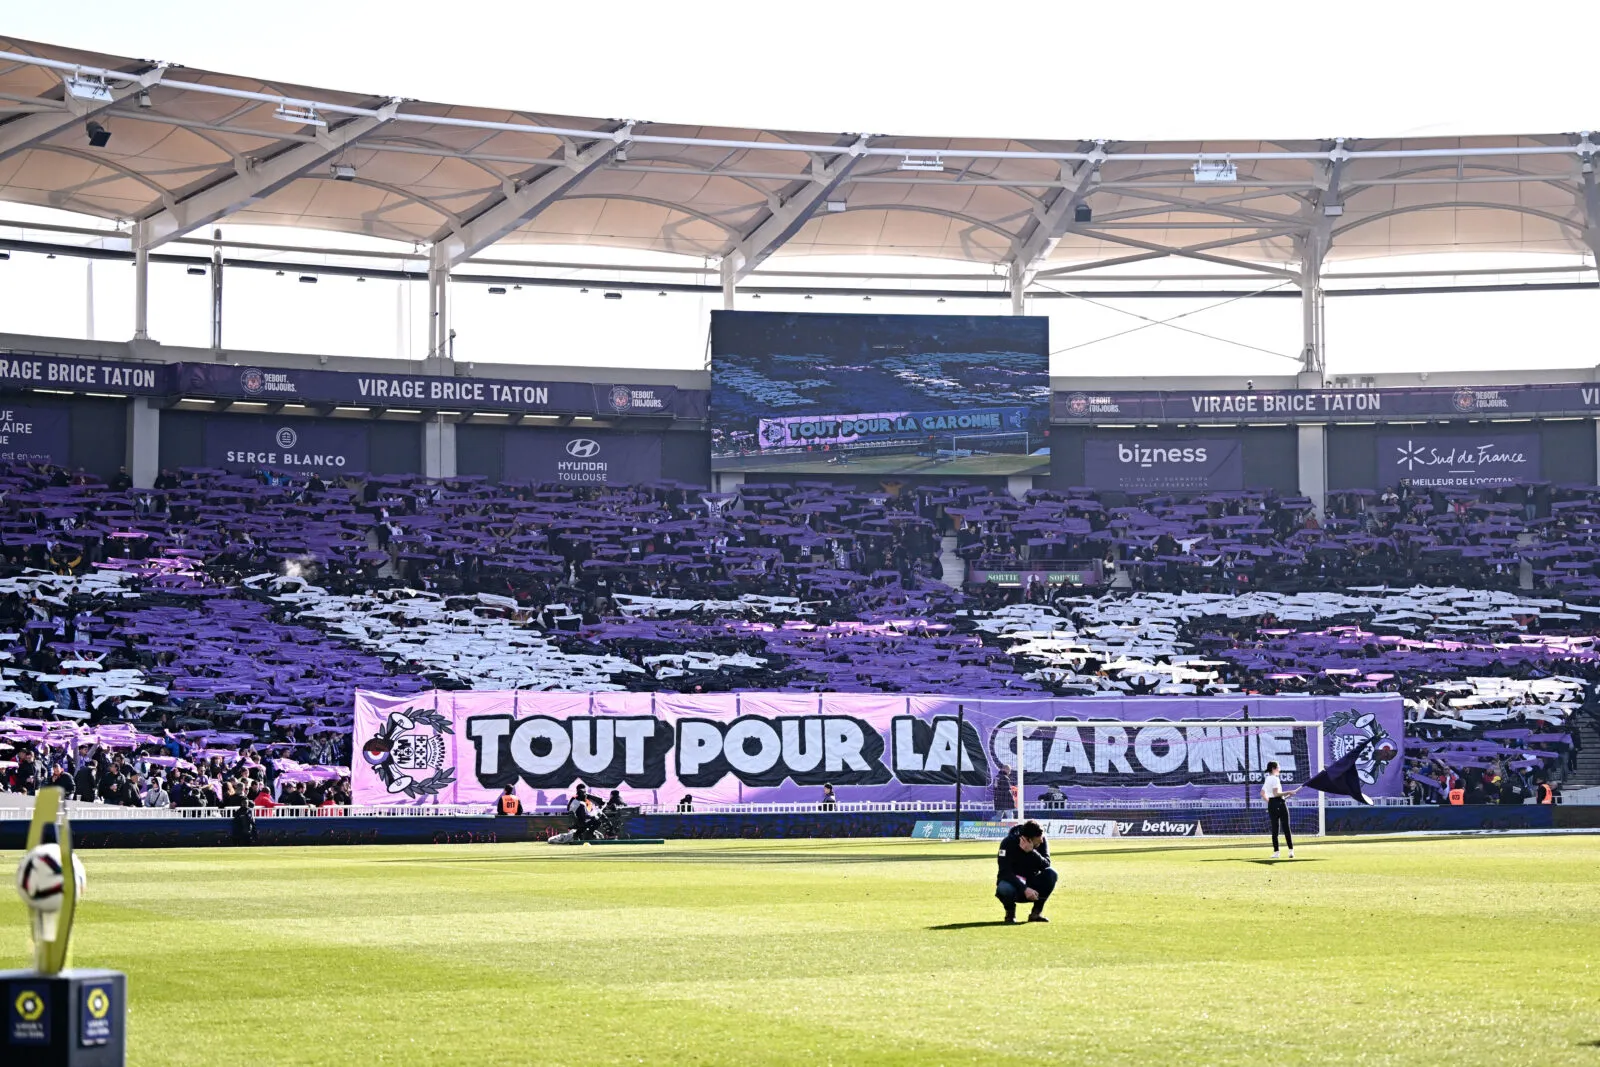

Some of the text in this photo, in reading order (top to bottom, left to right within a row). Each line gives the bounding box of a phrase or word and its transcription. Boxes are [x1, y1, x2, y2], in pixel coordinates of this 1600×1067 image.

[48, 362, 97, 383] BRICE
[103, 366, 156, 388] TATON
[358, 377, 549, 405] VIRAGE BRICE TATON
[1191, 393, 1381, 413] VIRAGE BRICE TATON
[789, 414, 1001, 438] TOUT POUR LA GARONNE
[227, 450, 346, 467] SERGE BLANCO
[1118, 443, 1208, 466] bizness
[1426, 443, 1527, 466] Sud de France
[558, 460, 608, 471] HYUNDAI
[558, 472, 608, 482] TOULOUSE
[1412, 478, 1454, 487] MEILLEUR
[1456, 477, 1469, 486] DE
[469, 717, 1297, 776] TOUT POUR LA GARONNE
[1058, 823, 1107, 835] newrest
[1141, 820, 1195, 835] betway
